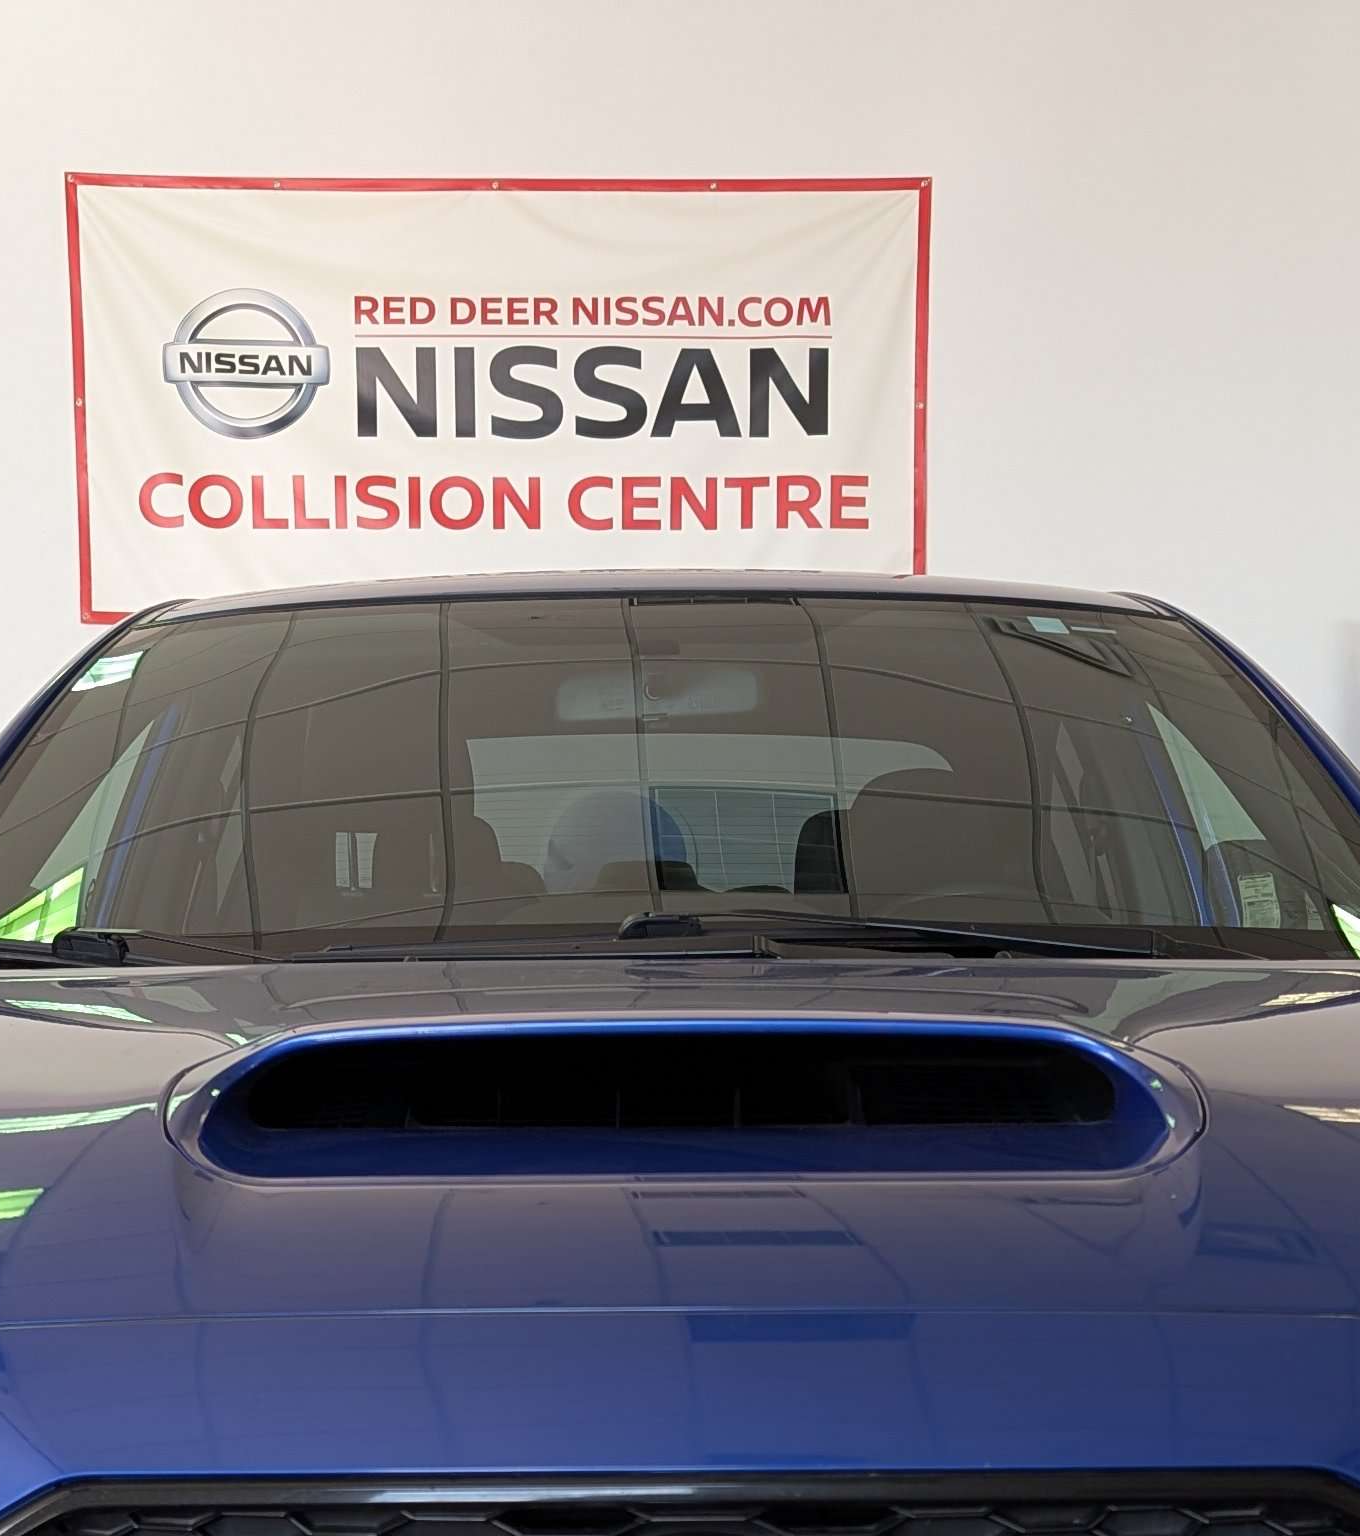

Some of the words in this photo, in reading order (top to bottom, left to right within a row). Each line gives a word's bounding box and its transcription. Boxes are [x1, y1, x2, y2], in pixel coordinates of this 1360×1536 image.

[354, 295, 436, 327] RED
[450, 296, 558, 327] DEER
[572, 296, 832, 328] NISSAN.COM
[179, 350, 313, 378] NISSAN
[355, 345, 830, 440] NISSAN
[138, 473, 542, 531] COLLISION
[568, 475, 870, 531] CENTRE
